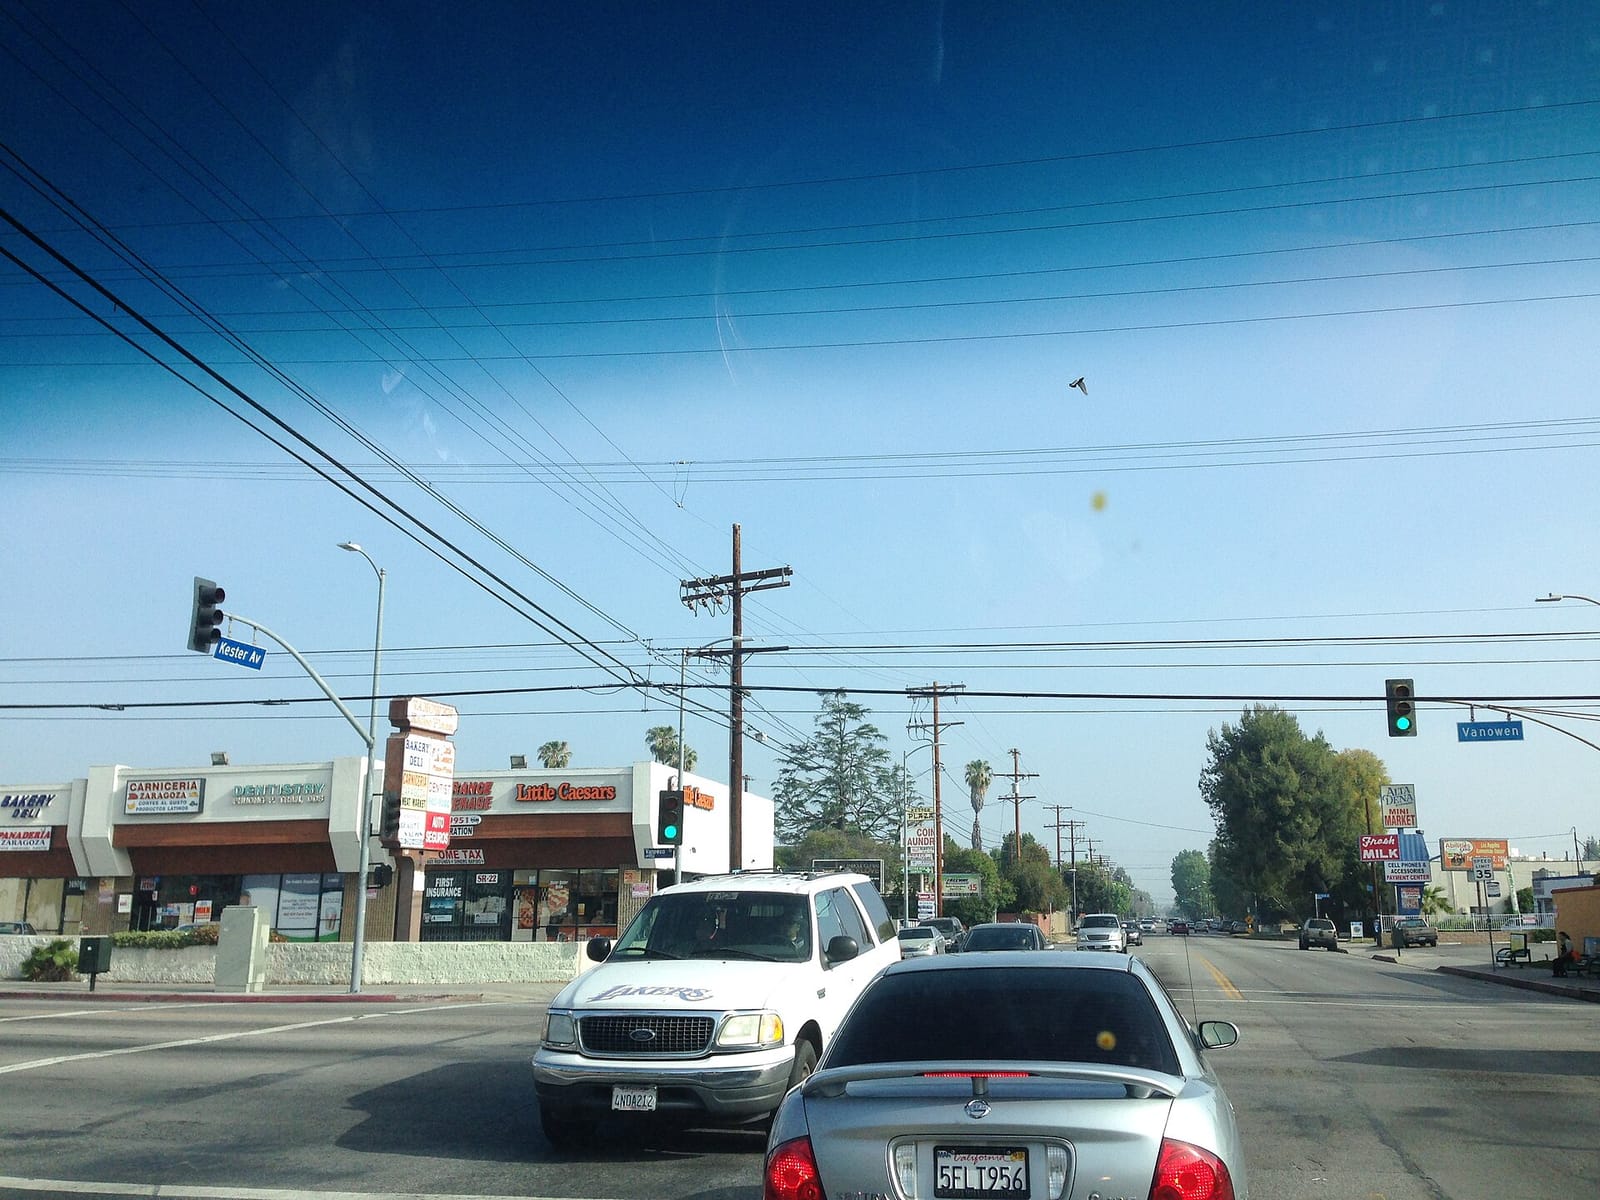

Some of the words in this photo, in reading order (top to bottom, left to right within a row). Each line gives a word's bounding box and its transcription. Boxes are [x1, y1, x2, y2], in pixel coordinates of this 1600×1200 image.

[219, 641, 248, 660] Kester
[249, 651, 261, 664] Av
[1462, 727, 1519, 737] Vanowen
[405, 739, 430, 753] BAKERY
[409, 755, 423, 767] DELI
[232, 783, 325, 797] DENTISTRY
[453, 781, 494, 795] RANCE
[516, 783, 556, 801] Little
[558, 782, 616, 800] Caesars
[1387, 786, 1410, 796] ALTA
[1, 794, 57, 807] BAKERY
[140, 791, 187, 799] ZARAGOZA
[1383, 794, 1414, 805] DENA
[12, 808, 42, 818] DELI
[432, 815, 445, 829] AUTO
[450, 816, 469, 824] 951
[1384, 815, 1416, 826] MARKET
[450, 827, 473, 836] RATION
[425, 832, 449, 844] SEGUROS
[907, 837, 935, 846] AUNDR
[1362, 835, 1395, 847] Fresh
[439, 850, 459, 859] OME
[463, 850, 482, 859] TAX
[1363, 849, 1398, 858] MILK
[1476, 870, 1491, 878] 35
[435, 878, 454, 887] FIRST
[426, 887, 461, 897] INSURANCE
[586, 984, 714, 1002] LAKERS
[954, 1154, 1009, 1165] California
